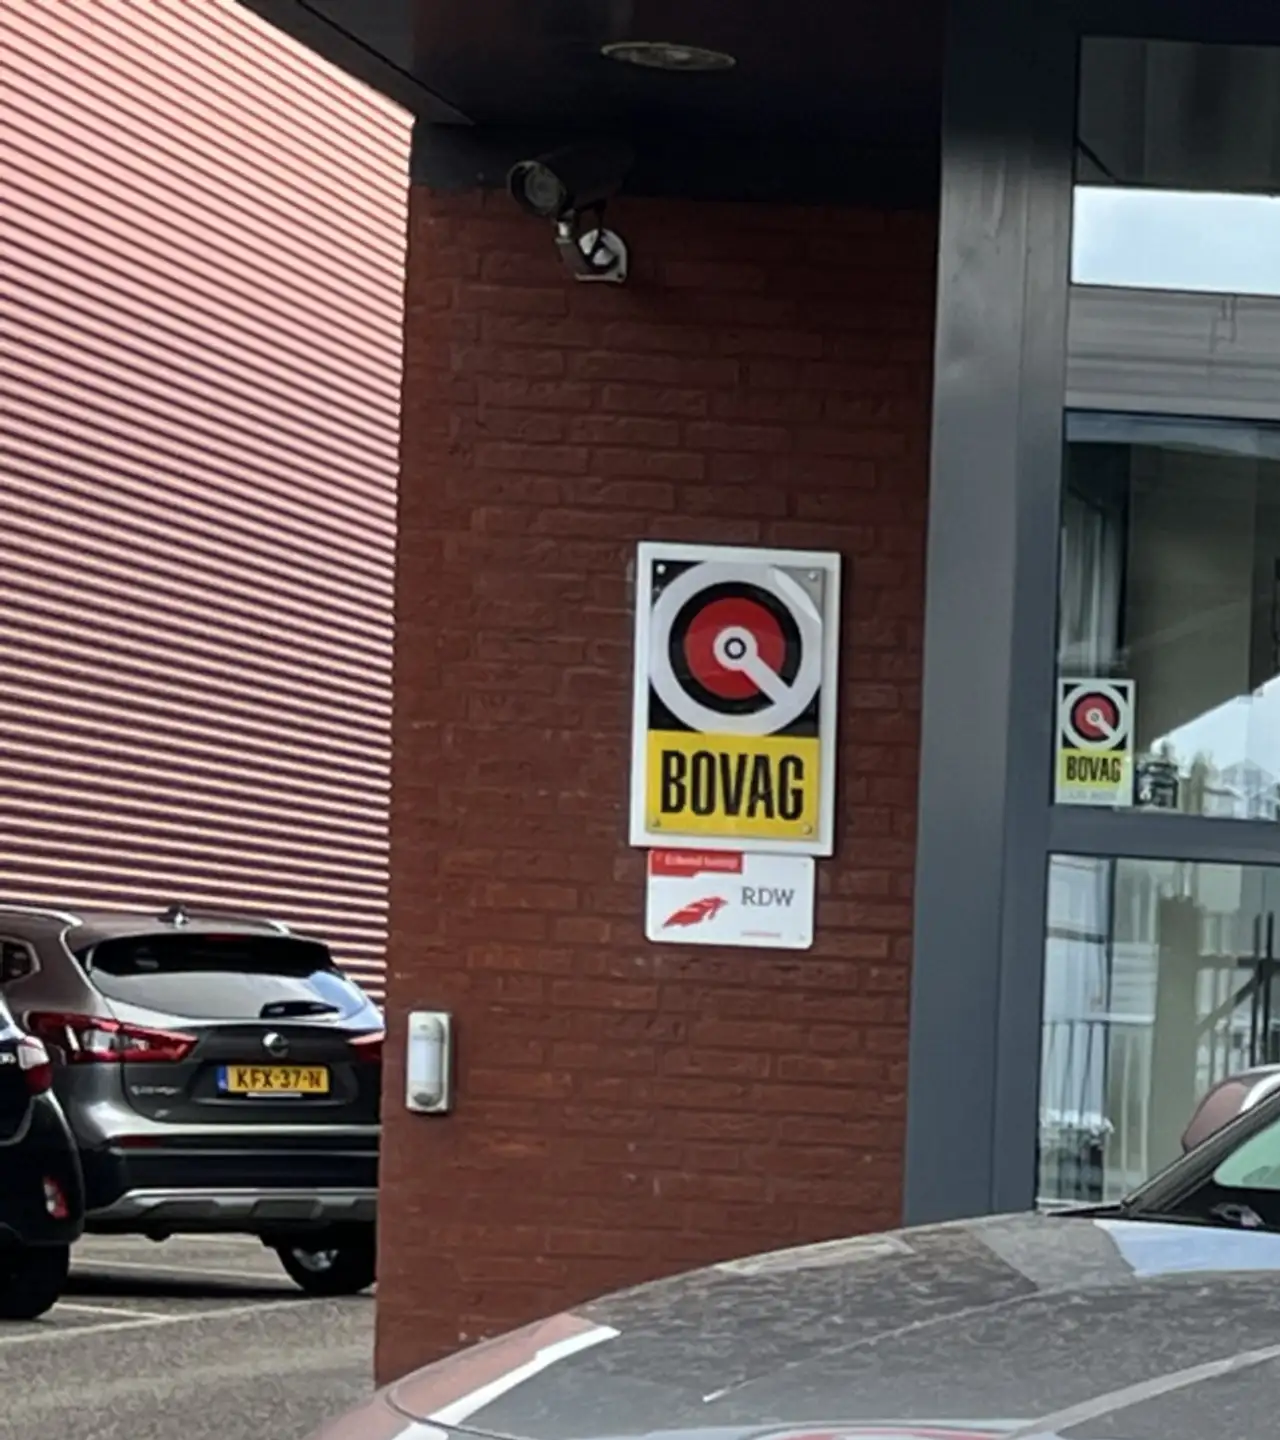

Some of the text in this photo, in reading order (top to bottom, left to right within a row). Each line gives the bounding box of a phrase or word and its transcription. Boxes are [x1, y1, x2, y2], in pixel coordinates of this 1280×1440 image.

[1066, 756, 1121, 784] BOVAG
[660, 749, 805, 821] BOVAG
[741, 885, 796, 908] RDW
[236, 1070, 322, 1090] KFX-37-N
